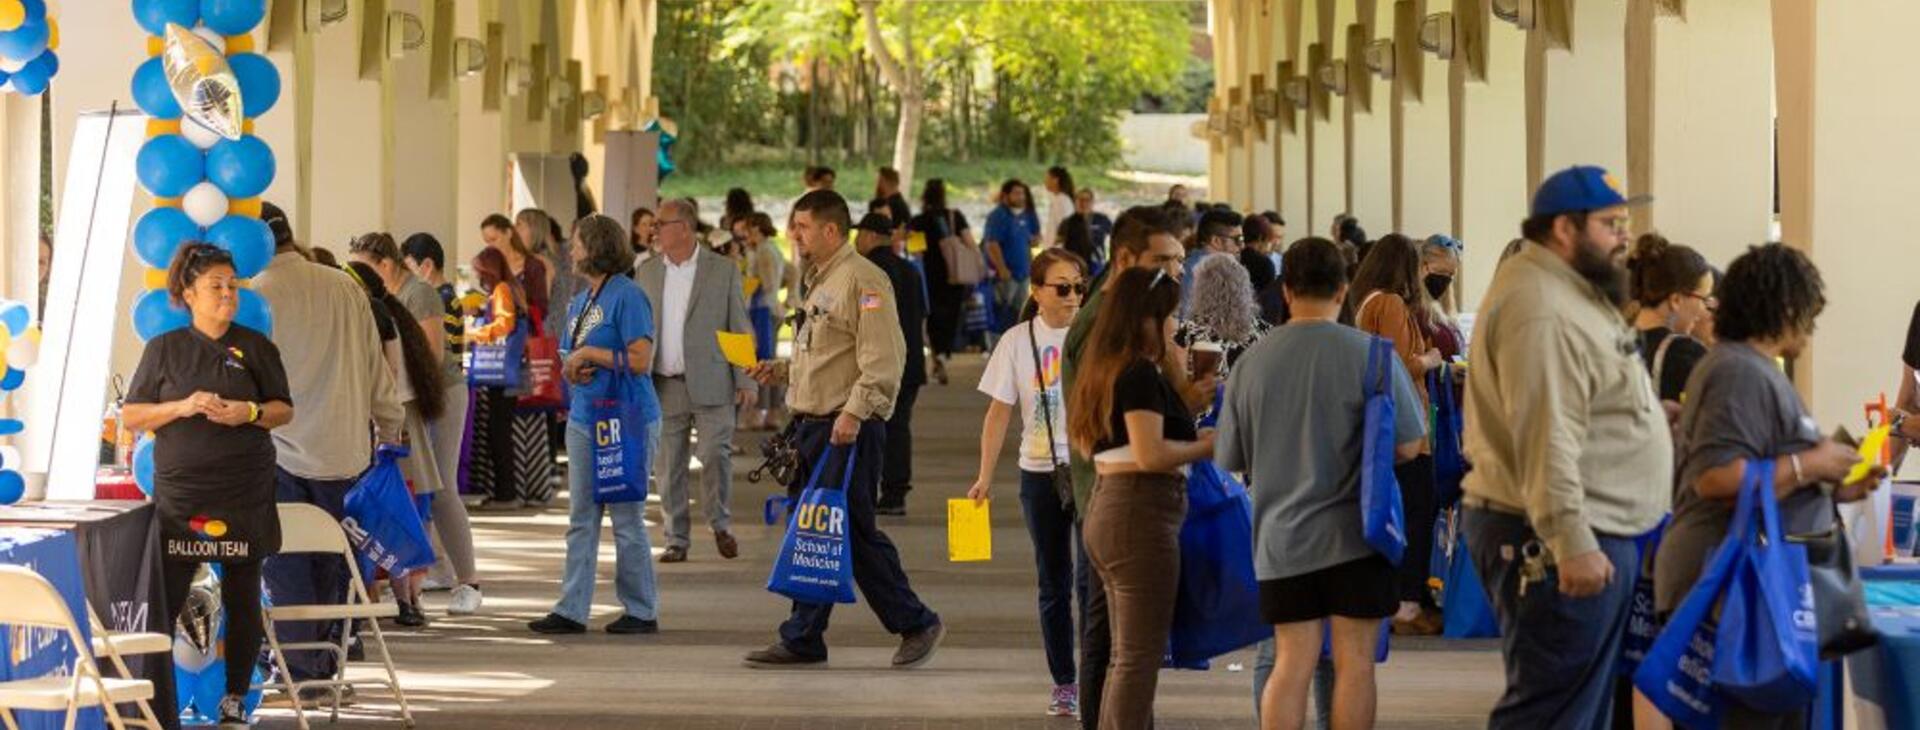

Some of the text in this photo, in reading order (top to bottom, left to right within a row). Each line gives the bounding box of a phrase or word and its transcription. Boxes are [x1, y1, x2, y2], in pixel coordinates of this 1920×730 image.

[596, 418, 621, 446] CR
[798, 503, 844, 535] UCR
[168, 539, 249, 557] BALLOON TEAM
[794, 537, 844, 556] School of
[792, 552, 840, 571] Medicine
